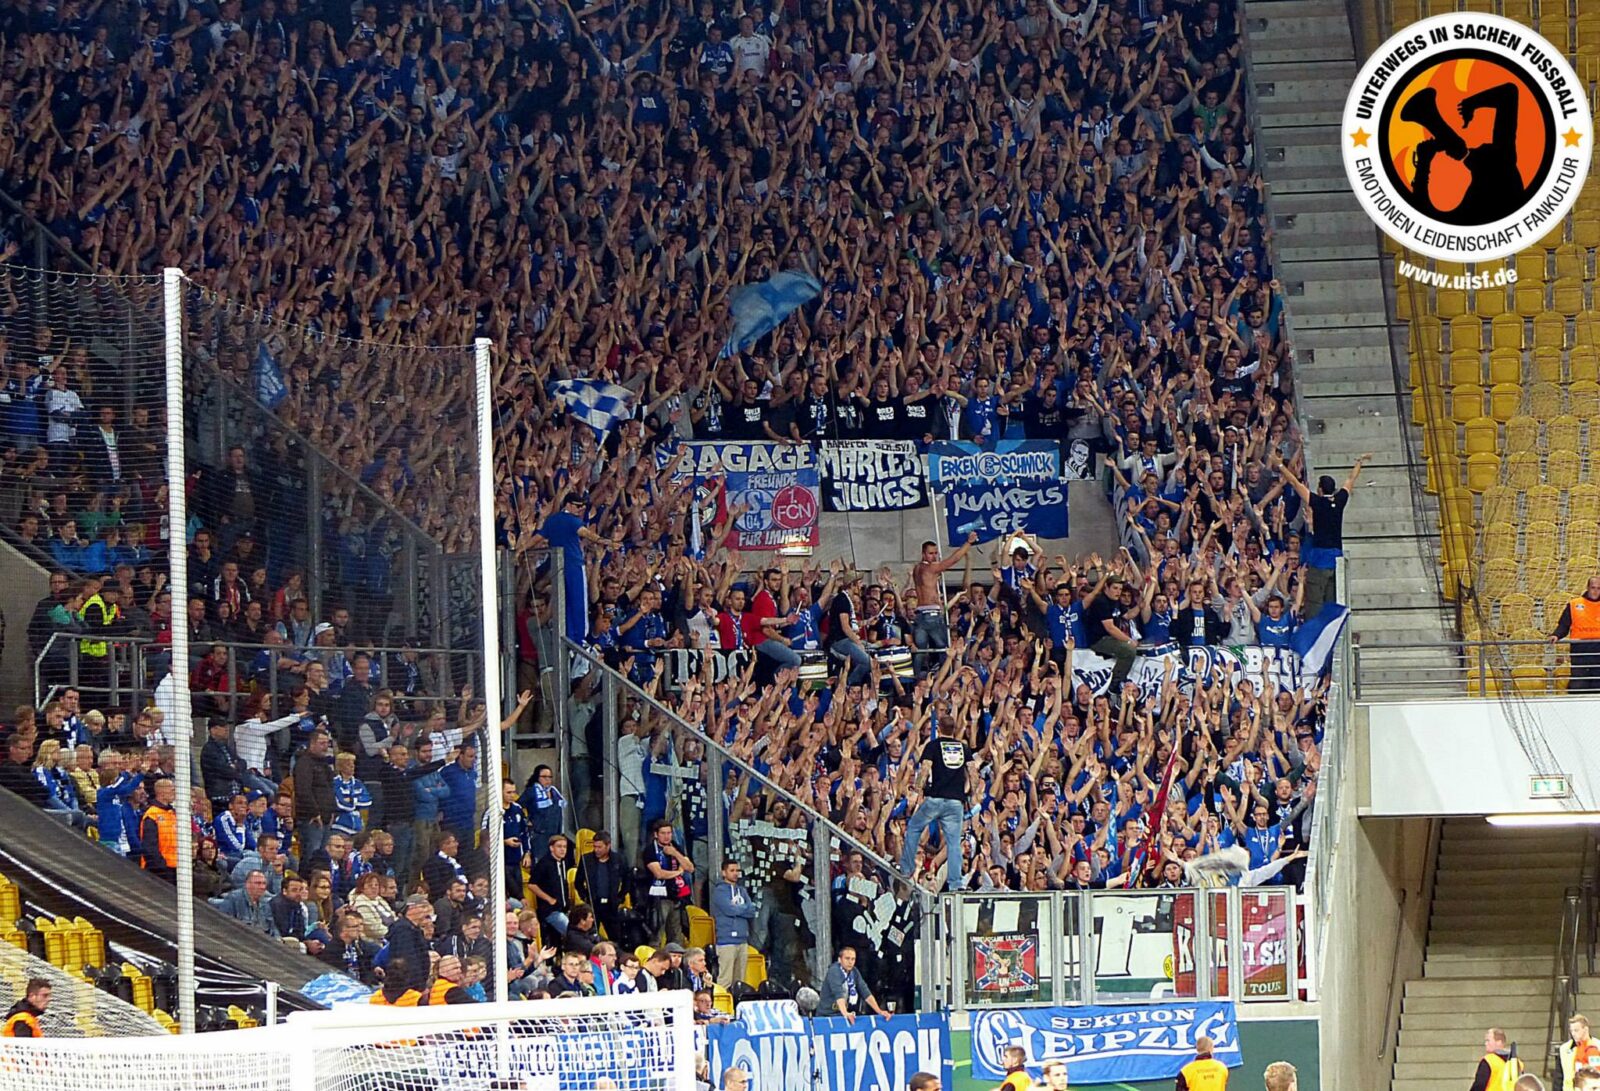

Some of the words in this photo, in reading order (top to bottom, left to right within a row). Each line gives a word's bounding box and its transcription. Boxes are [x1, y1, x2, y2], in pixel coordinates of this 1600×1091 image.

[677, 444, 813, 472] BAGAGE
[819, 448, 921, 483] MARLER
[941, 455, 979, 478] ERKEN
[1000, 452, 1054, 476] SCHWICK
[748, 472, 797, 489] FREUNDE
[832, 476, 920, 511] JUNGS
[953, 486, 1064, 517] KUMPELS
[777, 503, 812, 521] FCN
[990, 512, 1029, 533] GE
[739, 530, 763, 546] FÜR
[765, 526, 812, 545] IMMER!
[1250, 982, 1281, 993] TOUR
[1051, 1008, 1197, 1030] SEKTION
[1018, 1010, 1239, 1066] LEIPZIG
